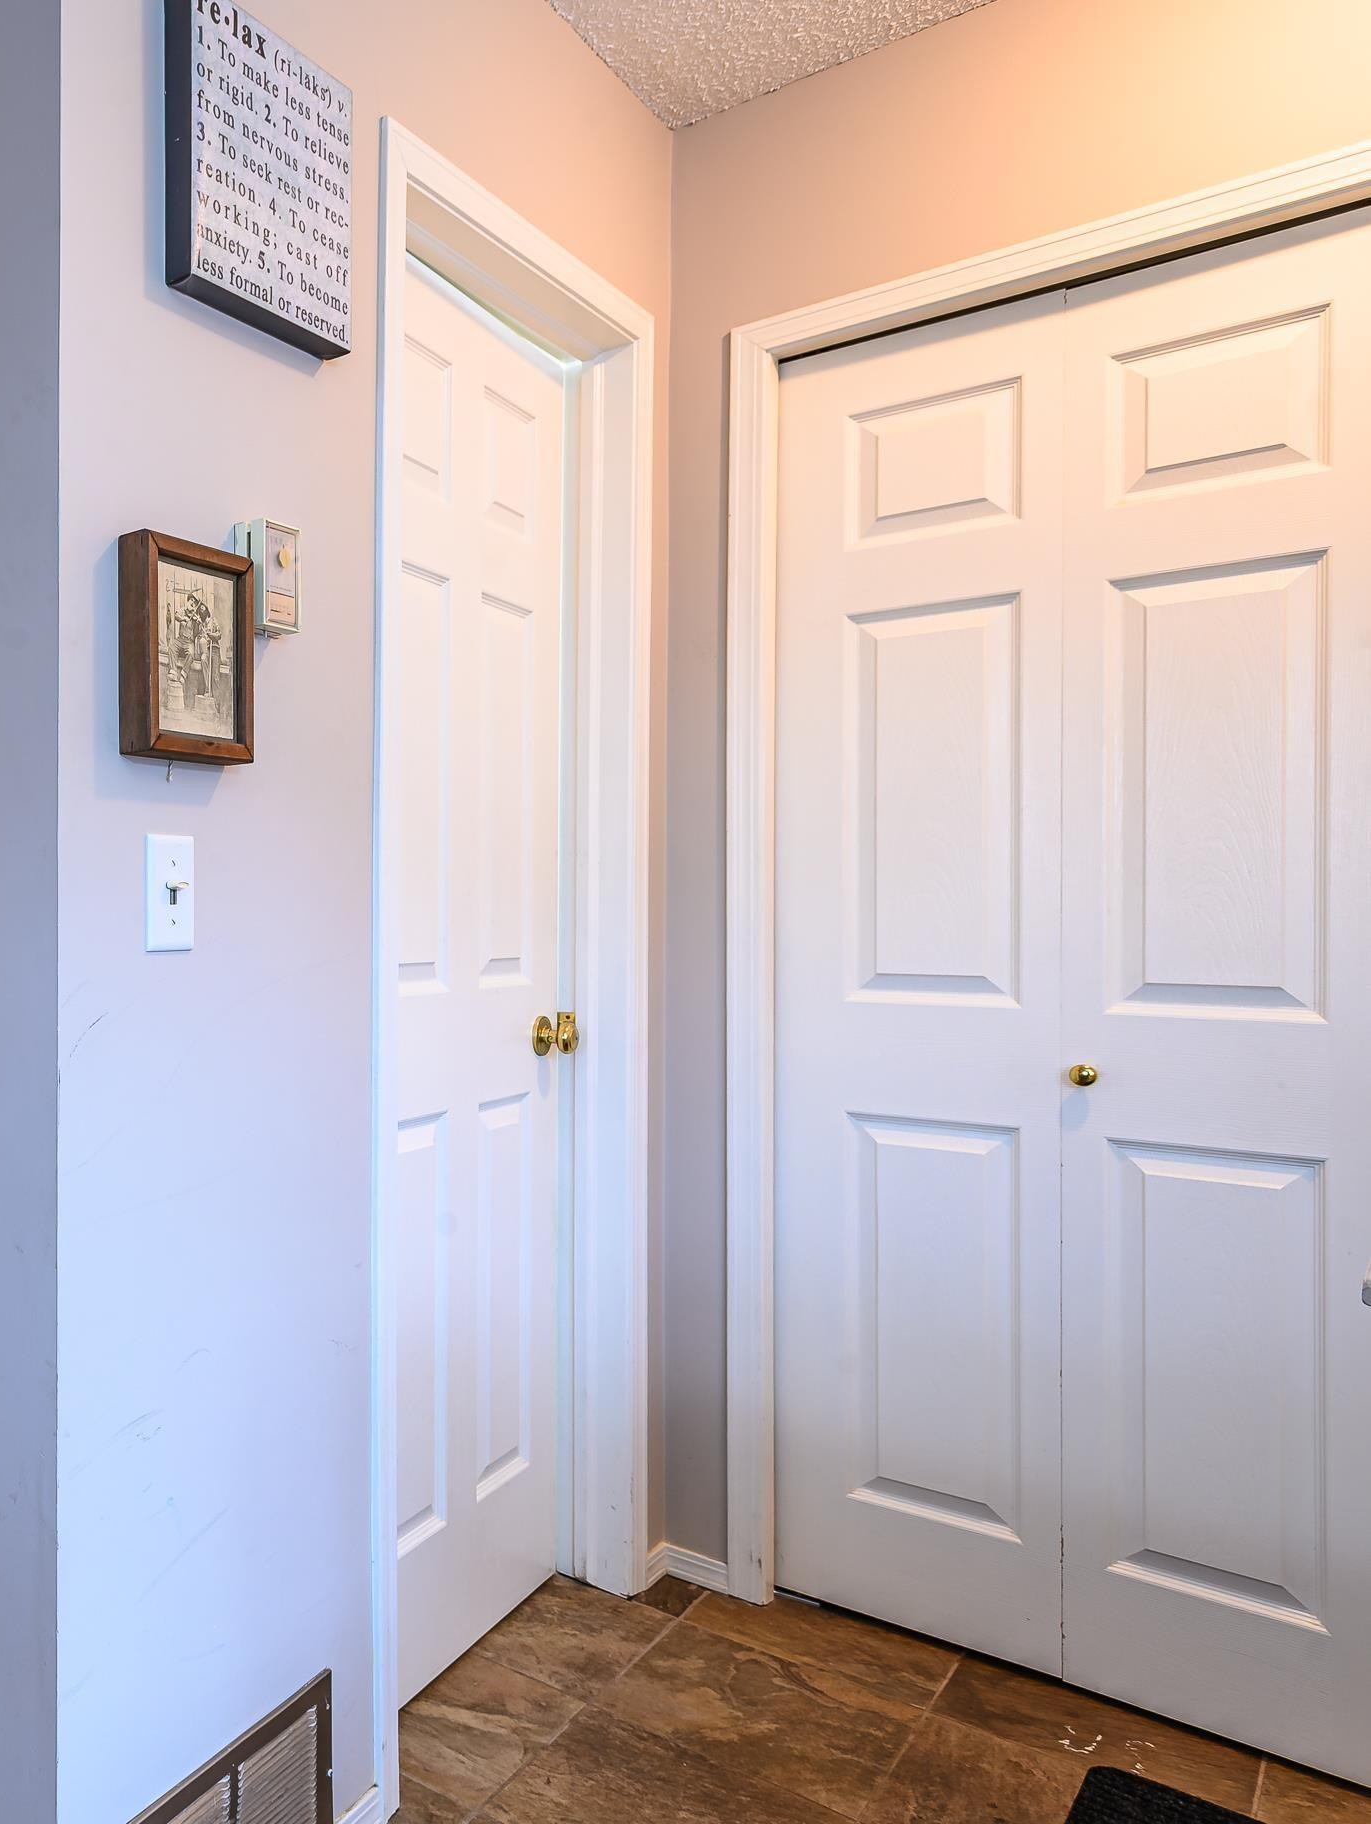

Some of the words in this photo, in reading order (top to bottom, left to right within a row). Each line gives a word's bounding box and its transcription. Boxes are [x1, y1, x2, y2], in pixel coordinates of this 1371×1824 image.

[197, 25, 211, 51] 1.
[218, 38, 235, 67] To
[243, 62, 279, 98] make
[285, 86, 311, 121] less
[317, 111, 349, 147] tense
[197, 62, 212, 83] or
[219, 75, 258, 115] rigid.
[264, 104, 276, 128] 2.
[283, 115, 299, 142] To
[305, 136, 349, 175] relieve
[338, 100, 347, 117] v.
[197, 89, 235, 129] from
[243, 122, 298, 172] nervous
[305, 166, 348, 204] stress.
[197, 121, 211, 146] 3.
[218, 133, 236, 160] To
[243, 154, 272, 184] seek
[278, 177, 301, 203] rest
[307, 196, 320, 214] or
[325, 207, 349, 229] rec-
[196, 158, 261, 207] reation.
[269, 197, 281, 220] 4.
[289, 208, 306, 233] To
[312, 228, 349, 259] cease
[197, 190, 277, 250] working;
[287, 241, 317, 270] cast
[326, 265, 349, 287] off
[197, 223, 252, 265] anxiety.
[258, 250, 270, 273] 5.
[277, 260, 293, 285] To
[300, 273, 348, 315] become
[197, 248, 223, 279] less
[230, 266, 273, 305] formal
[278, 297, 291, 313] or
[295, 305, 349, 344] reserved.
